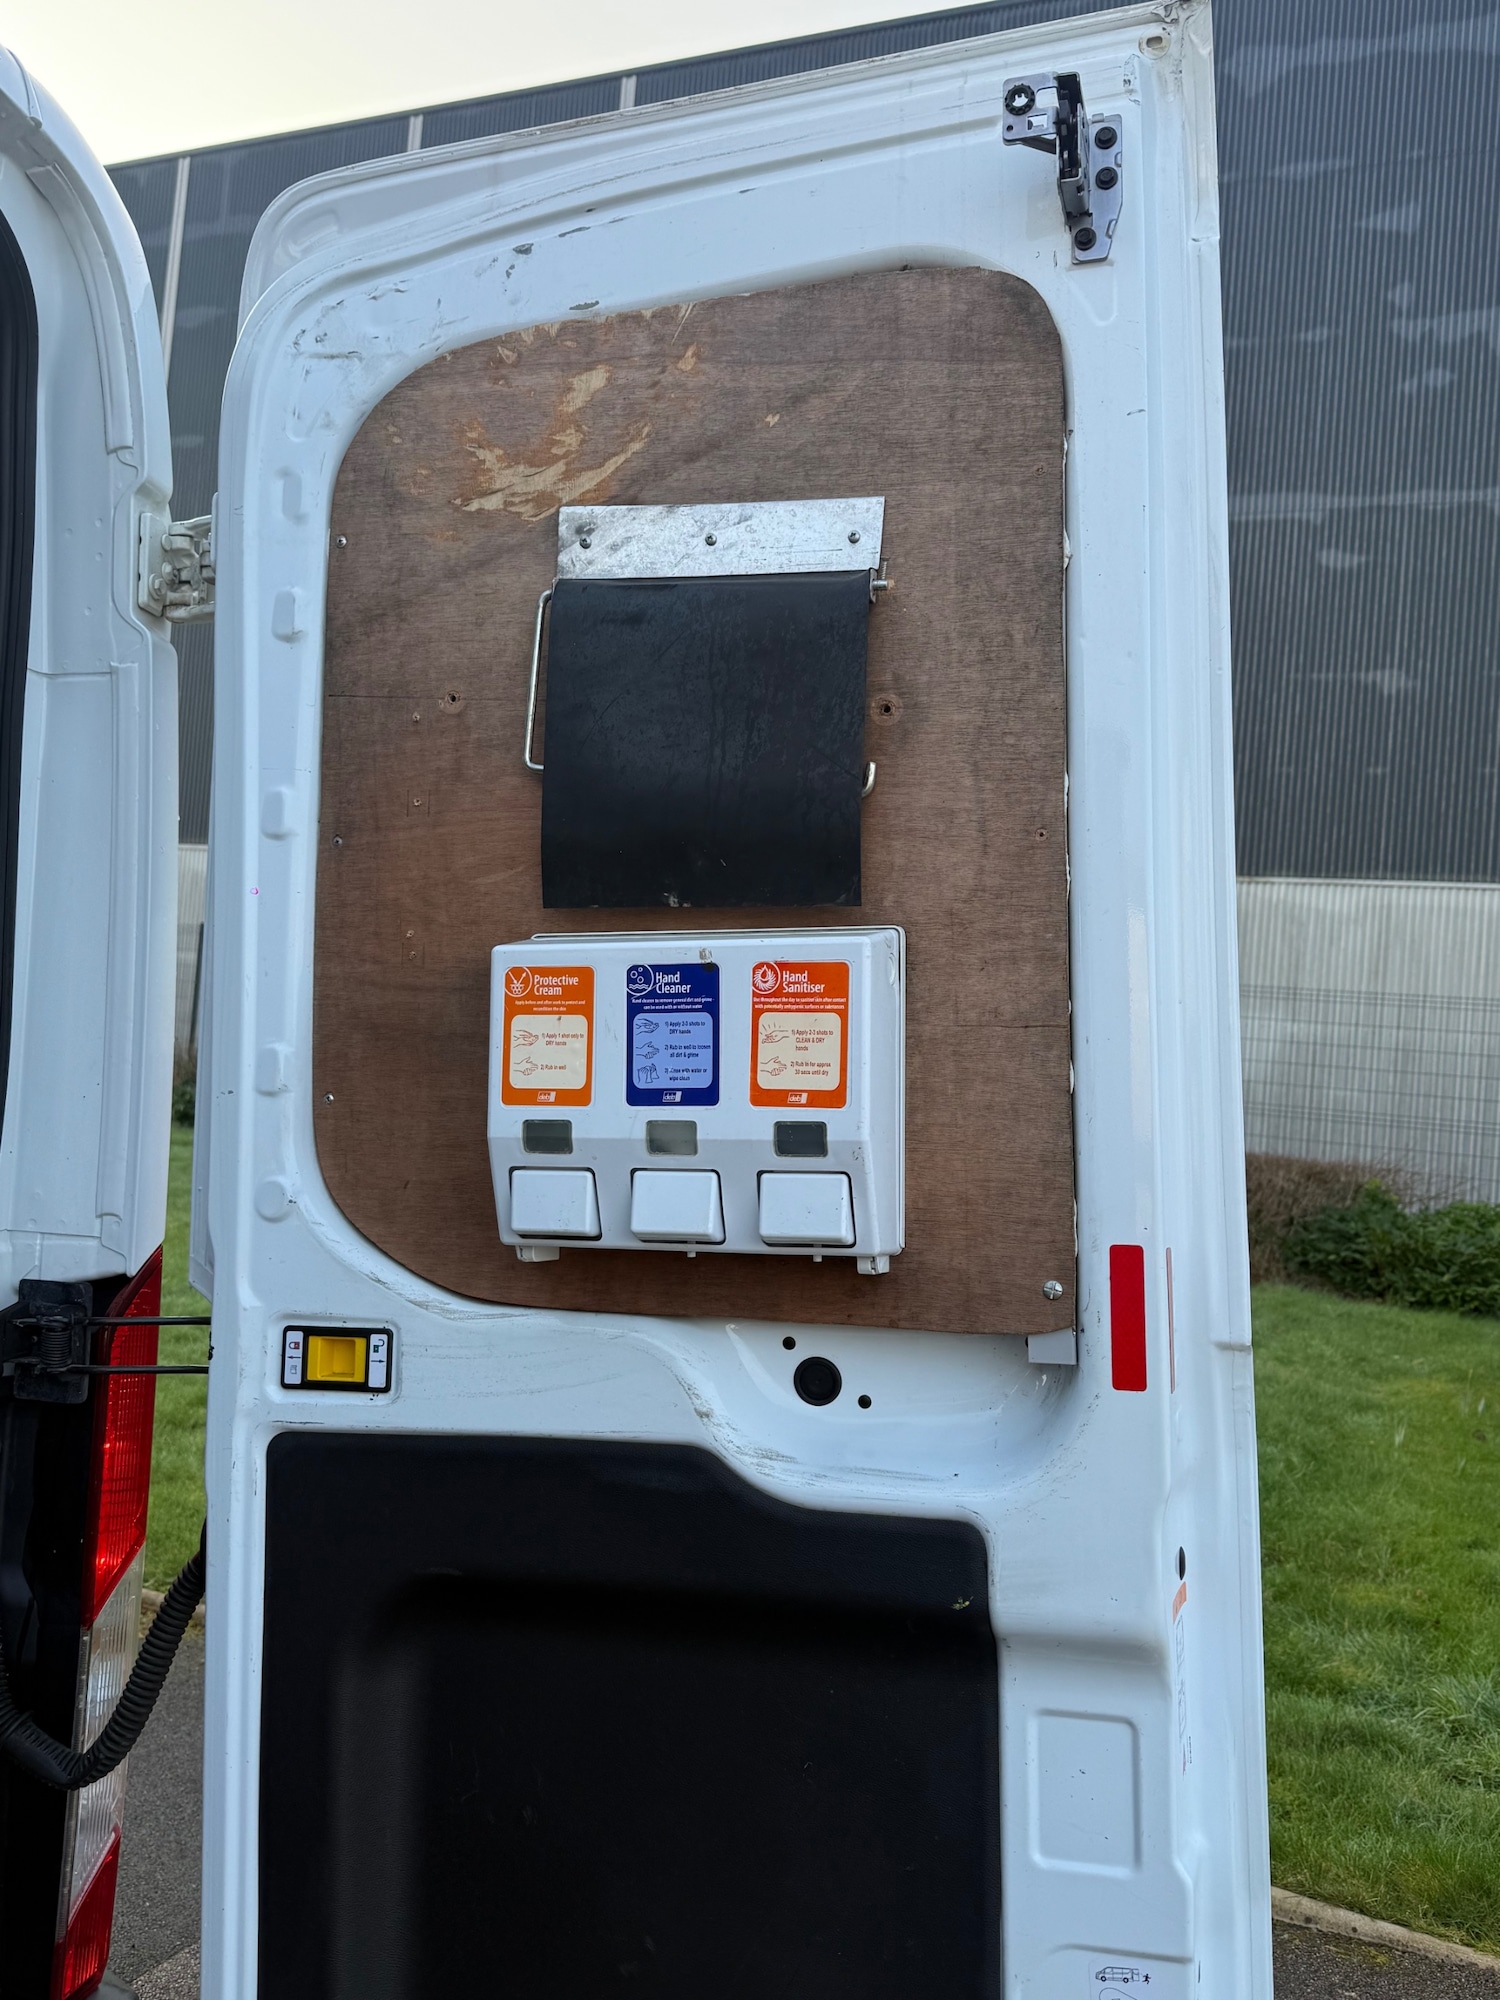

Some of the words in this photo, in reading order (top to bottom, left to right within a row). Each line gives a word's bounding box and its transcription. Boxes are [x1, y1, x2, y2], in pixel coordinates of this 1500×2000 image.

[534, 975, 578, 985] Protective
[656, 972, 680, 983] Hand
[783, 970, 807, 982] Hand
[534, 985, 562, 995] Cream
[656, 983, 691, 993] Cleaner
[783, 982, 825, 993] Sanitiser
